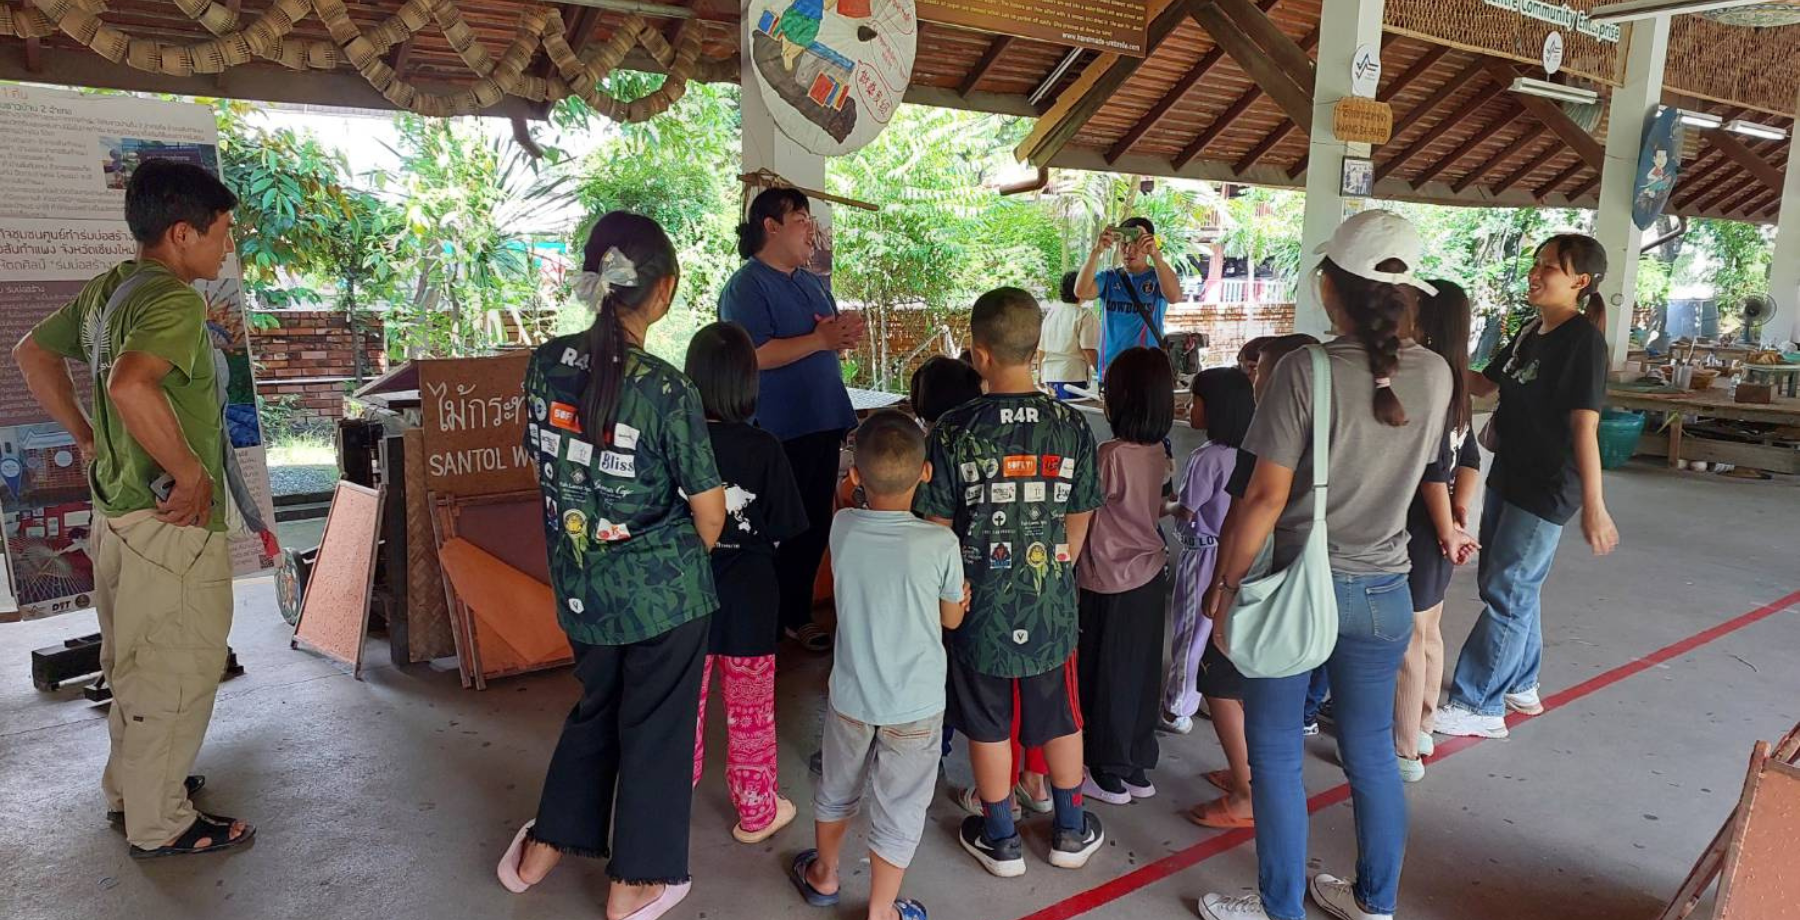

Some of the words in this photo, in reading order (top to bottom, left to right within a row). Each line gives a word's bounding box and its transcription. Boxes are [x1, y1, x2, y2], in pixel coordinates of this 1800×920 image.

[1522, 0, 1577, 28] Community
[560, 347, 591, 370] R4
[1000, 407, 1040, 425] R4R
[429, 447, 507, 476] SANTOL
[512, 445, 529, 468] W
[601, 452, 635, 473] Bliss
